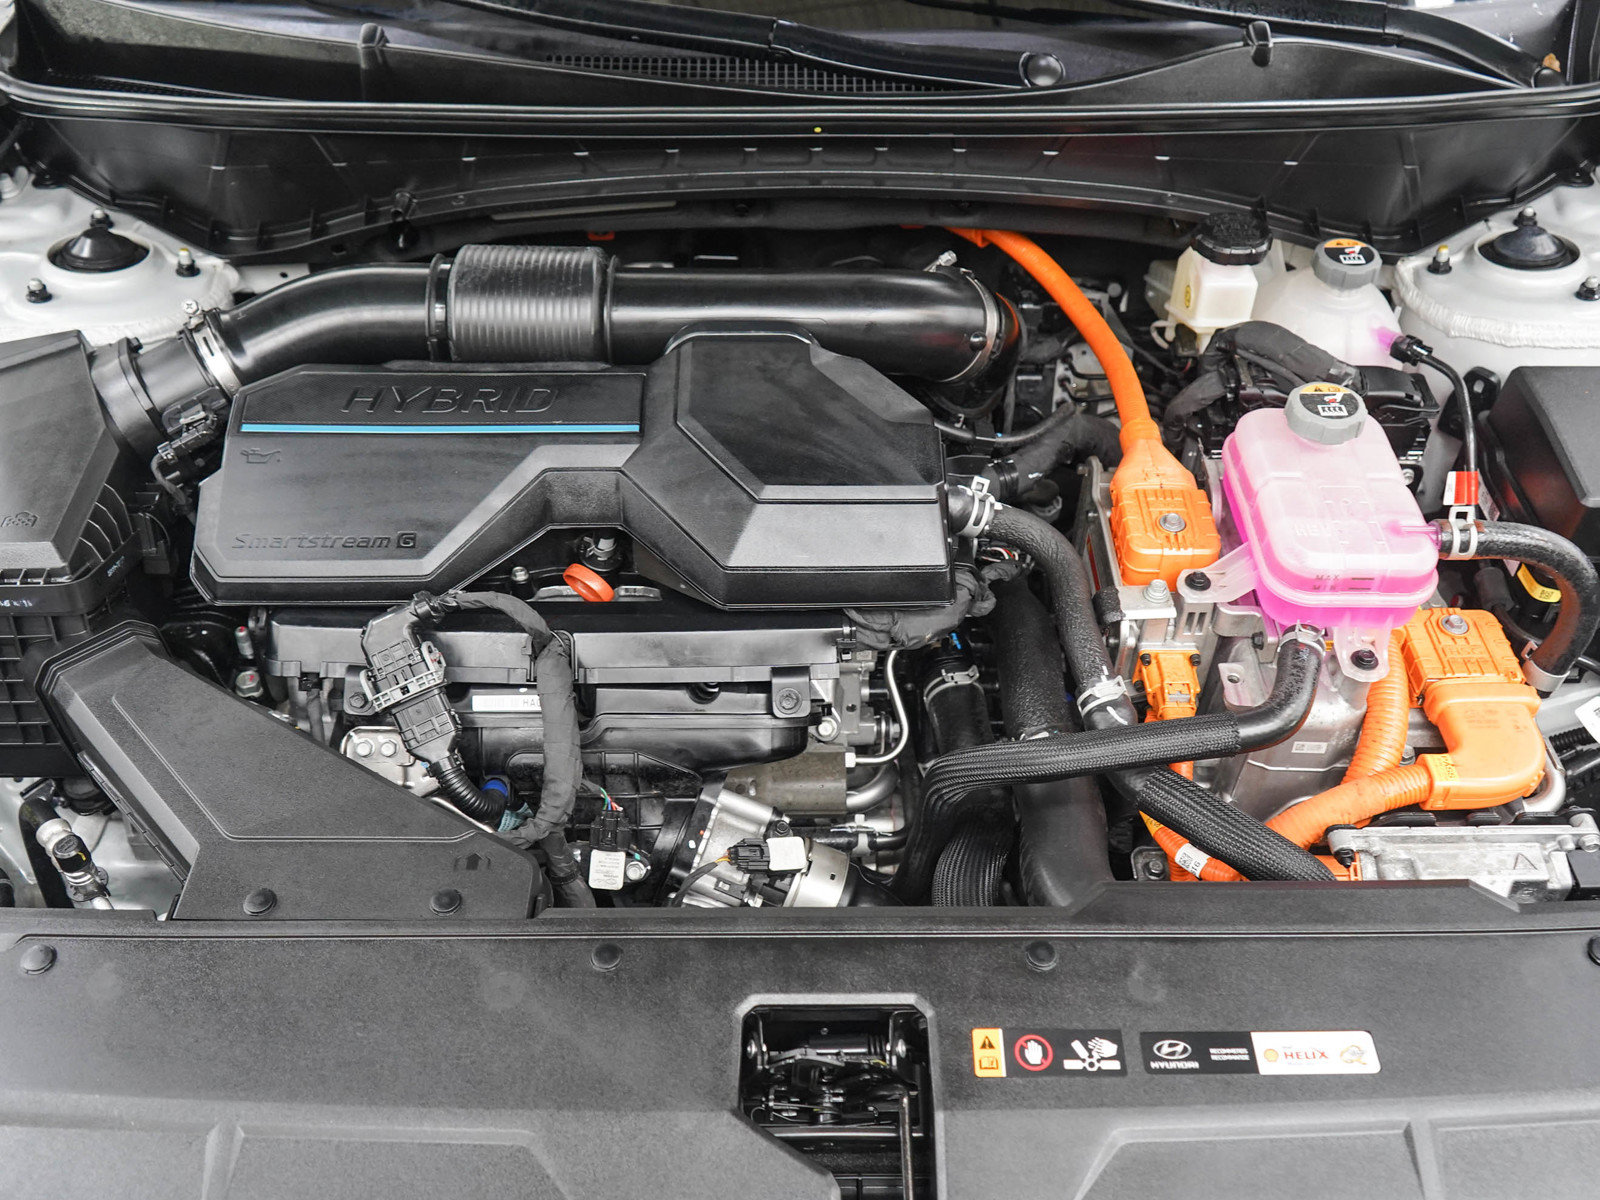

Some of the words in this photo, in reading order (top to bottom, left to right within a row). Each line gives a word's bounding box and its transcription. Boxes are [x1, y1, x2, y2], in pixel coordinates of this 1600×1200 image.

[341, 382, 558, 413] HYBRID
[231, 532, 391, 549] Smartstream
[397, 531, 417, 549] G
[1284, 1048, 1328, 1060] HELIX
[1149, 1060, 1200, 1069] HYUNDAI
